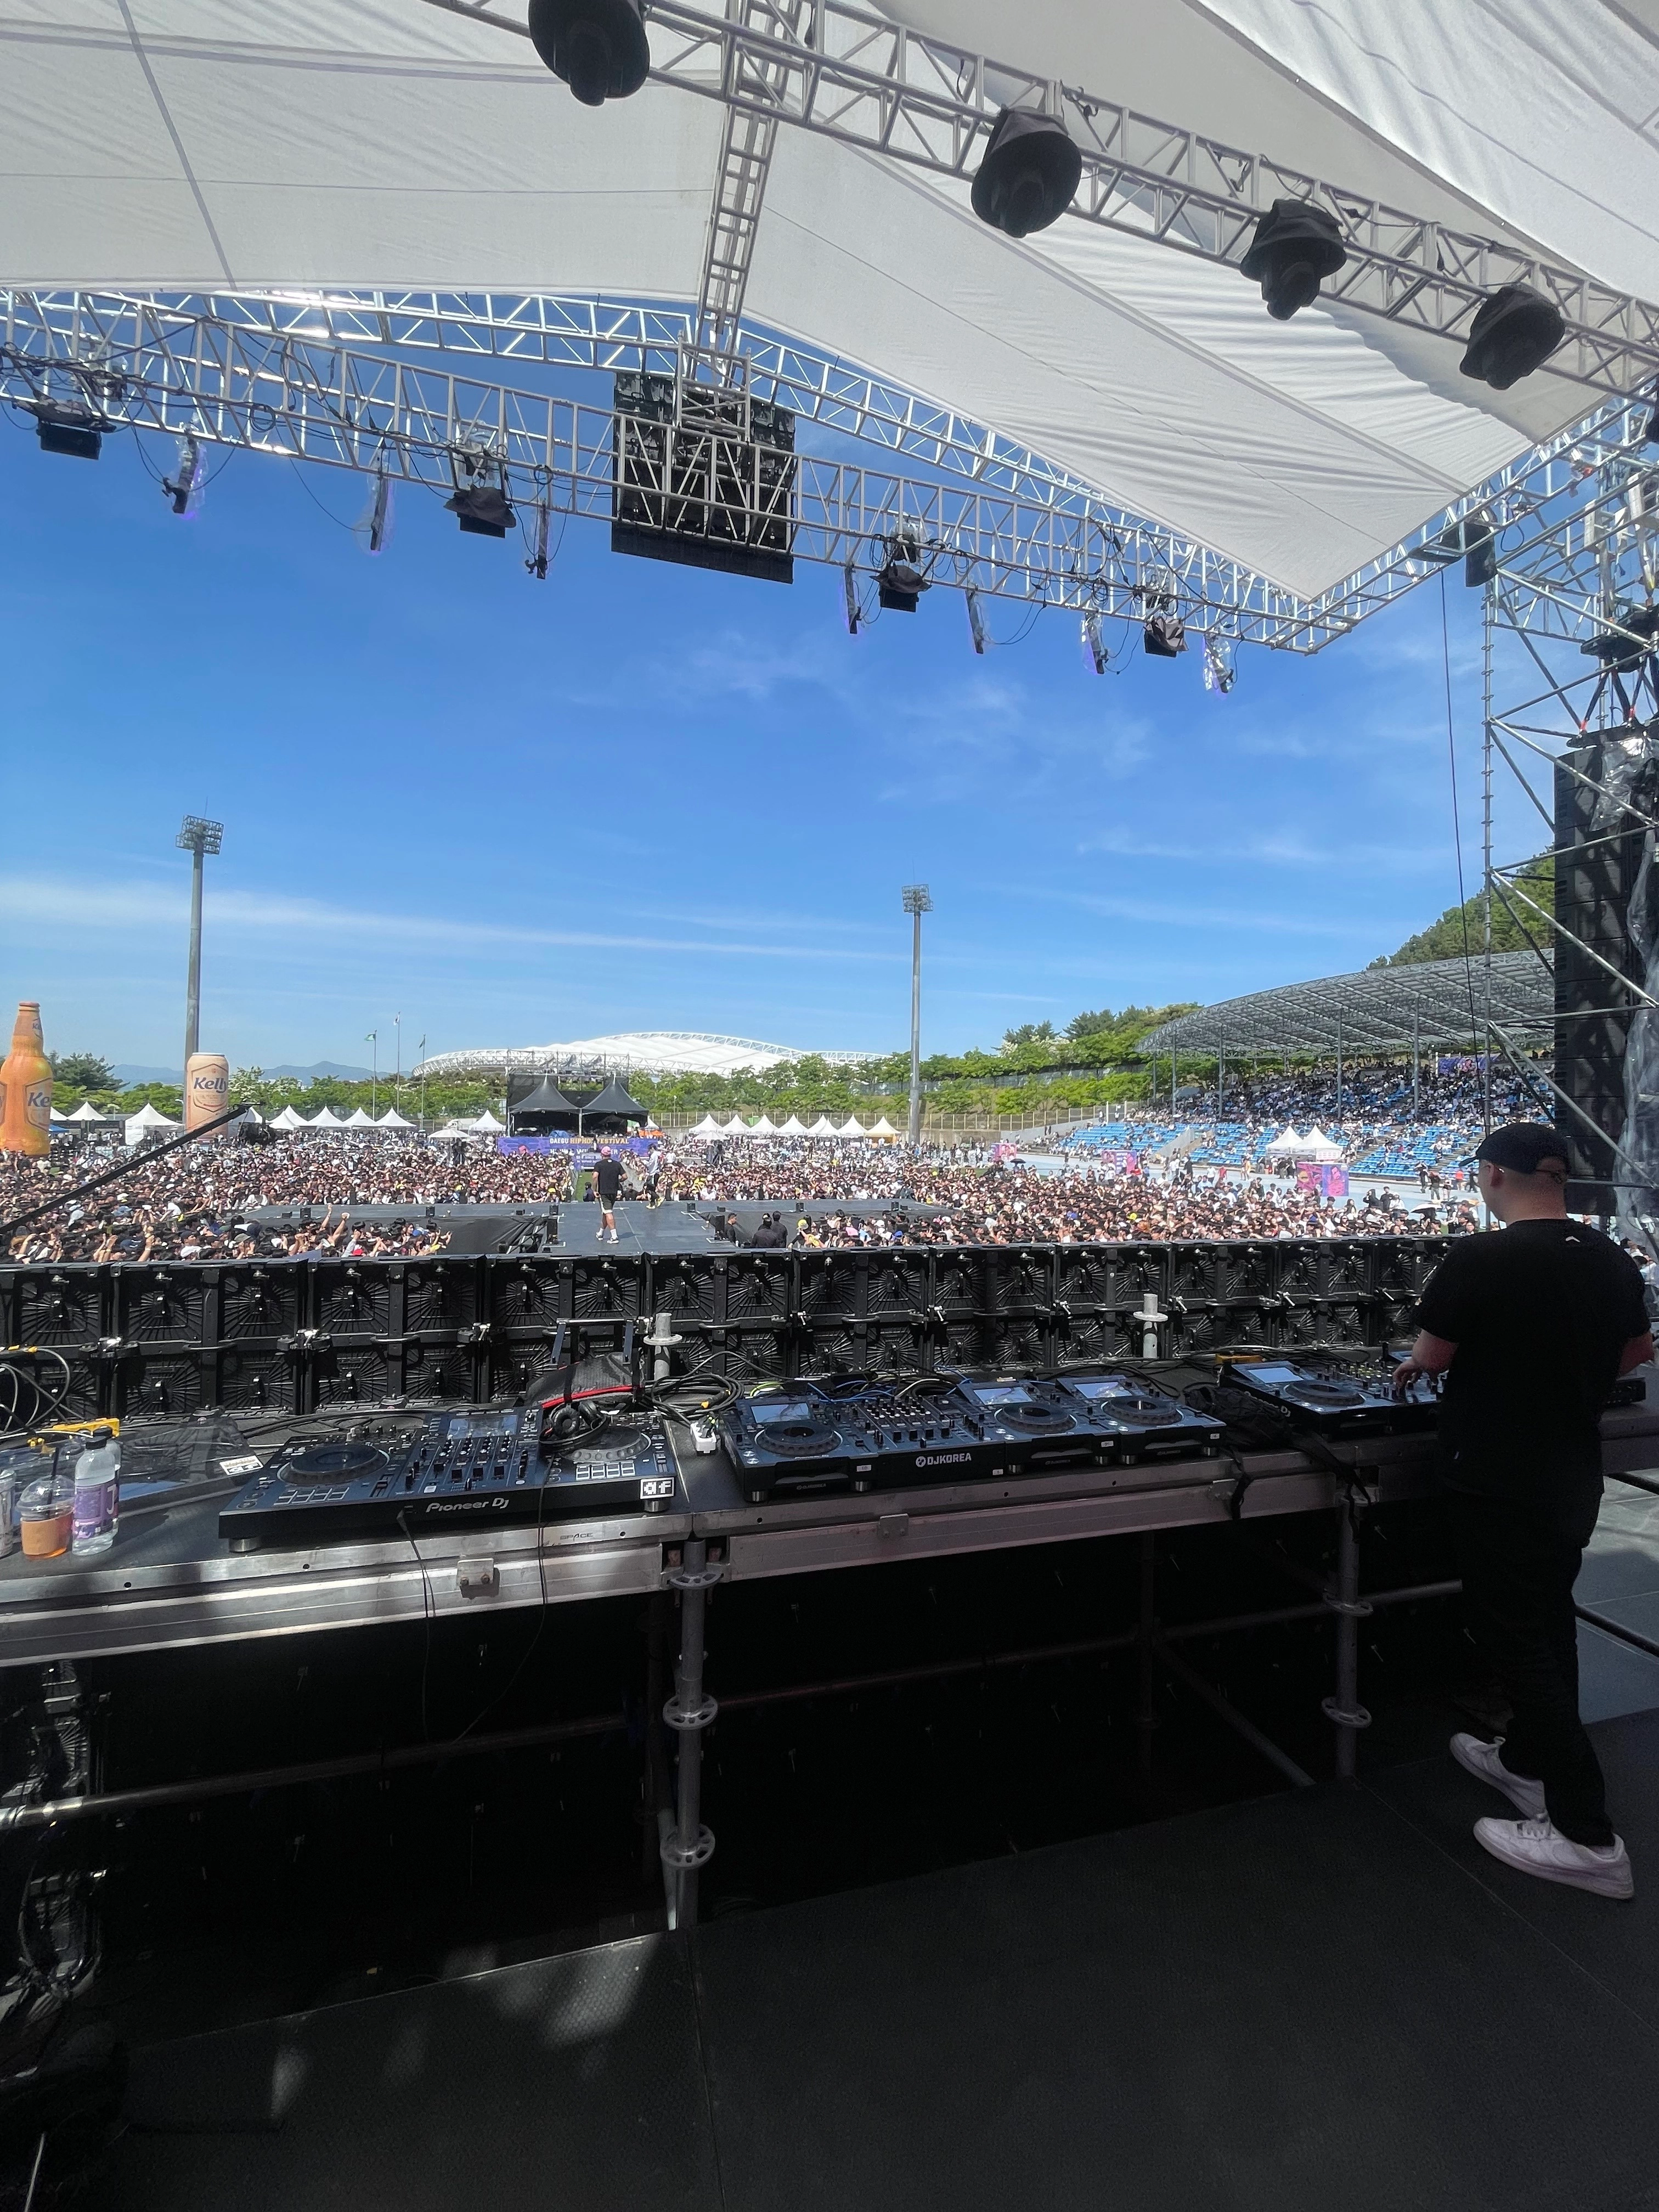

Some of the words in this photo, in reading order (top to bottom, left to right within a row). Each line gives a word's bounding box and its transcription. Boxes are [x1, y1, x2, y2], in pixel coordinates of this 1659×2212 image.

[194, 1077, 227, 1093] Kelly
[927, 1453, 972, 1465] DJKOREA
[426, 1500, 489, 1513] Pioneer
[560, 1532, 593, 1542] SPACE
